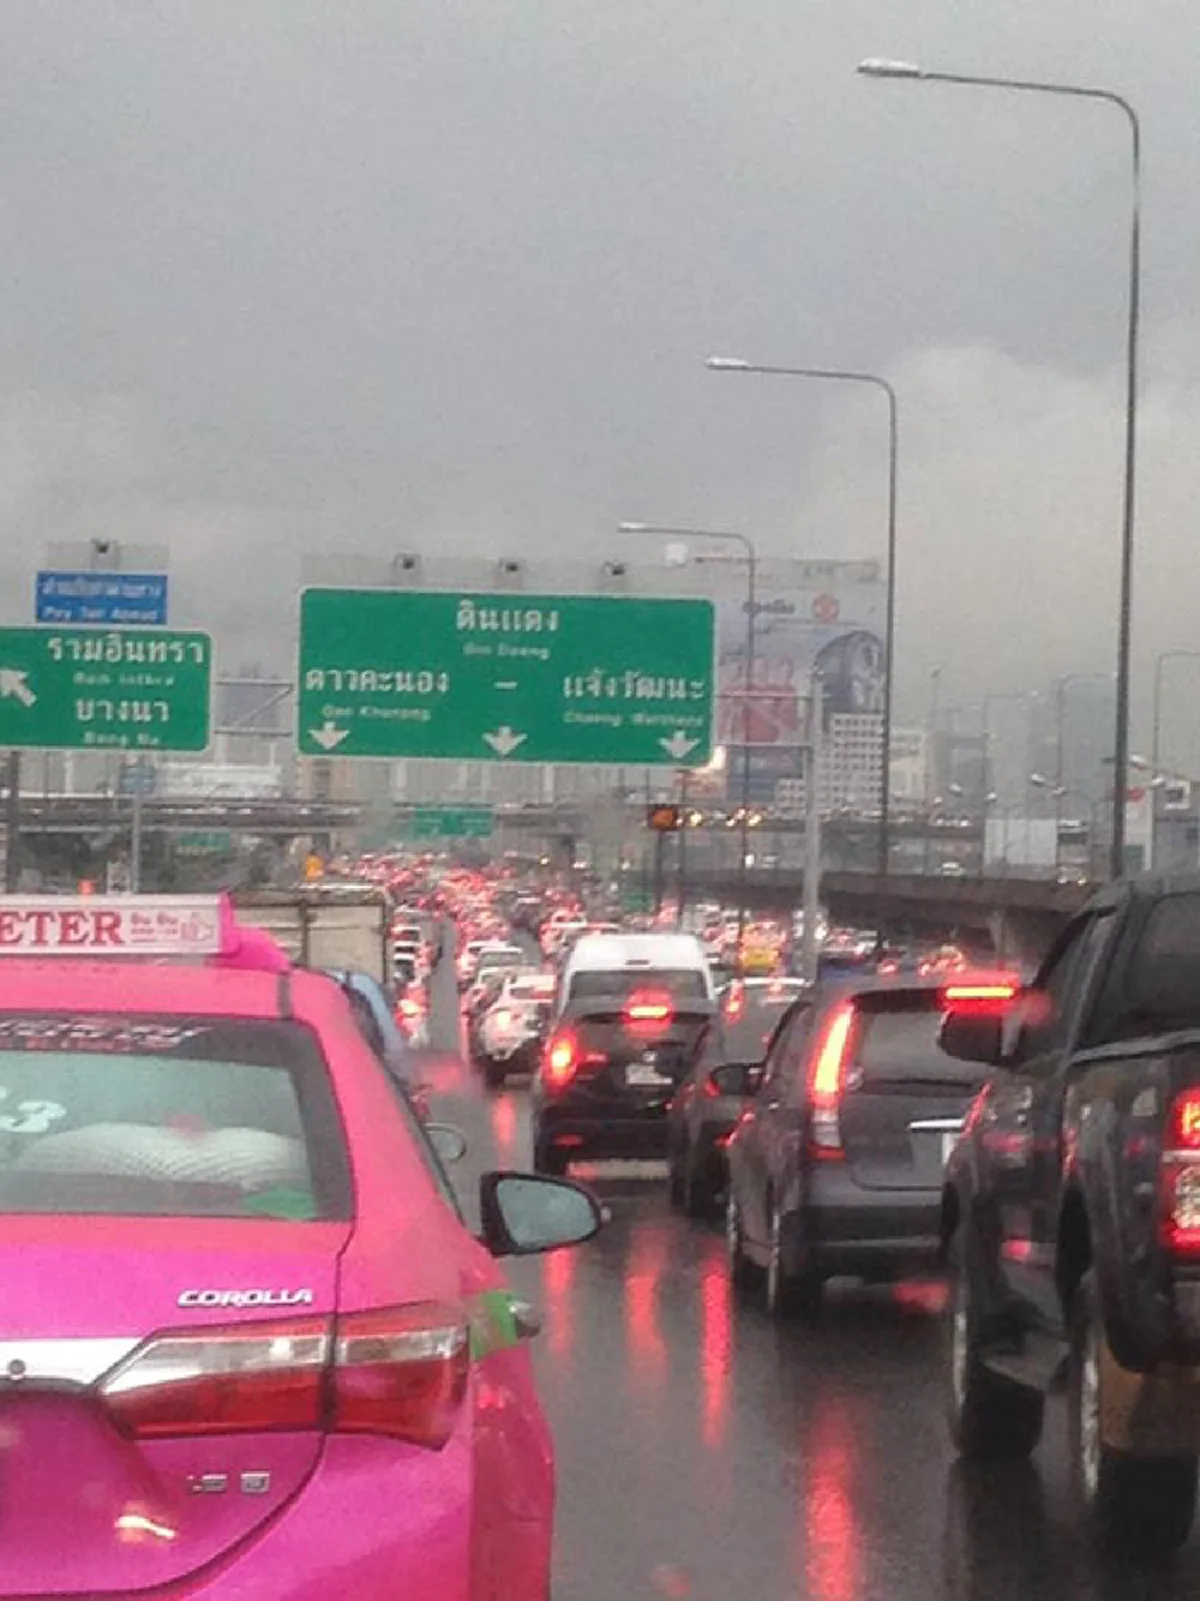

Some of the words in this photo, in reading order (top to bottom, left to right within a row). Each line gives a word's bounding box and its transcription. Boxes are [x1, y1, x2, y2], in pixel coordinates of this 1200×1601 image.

[47, 633, 204, 663] รามอินทรา
[76, 699, 170, 722] บางนา
[178, 1288, 312, 1307] COROLLA
